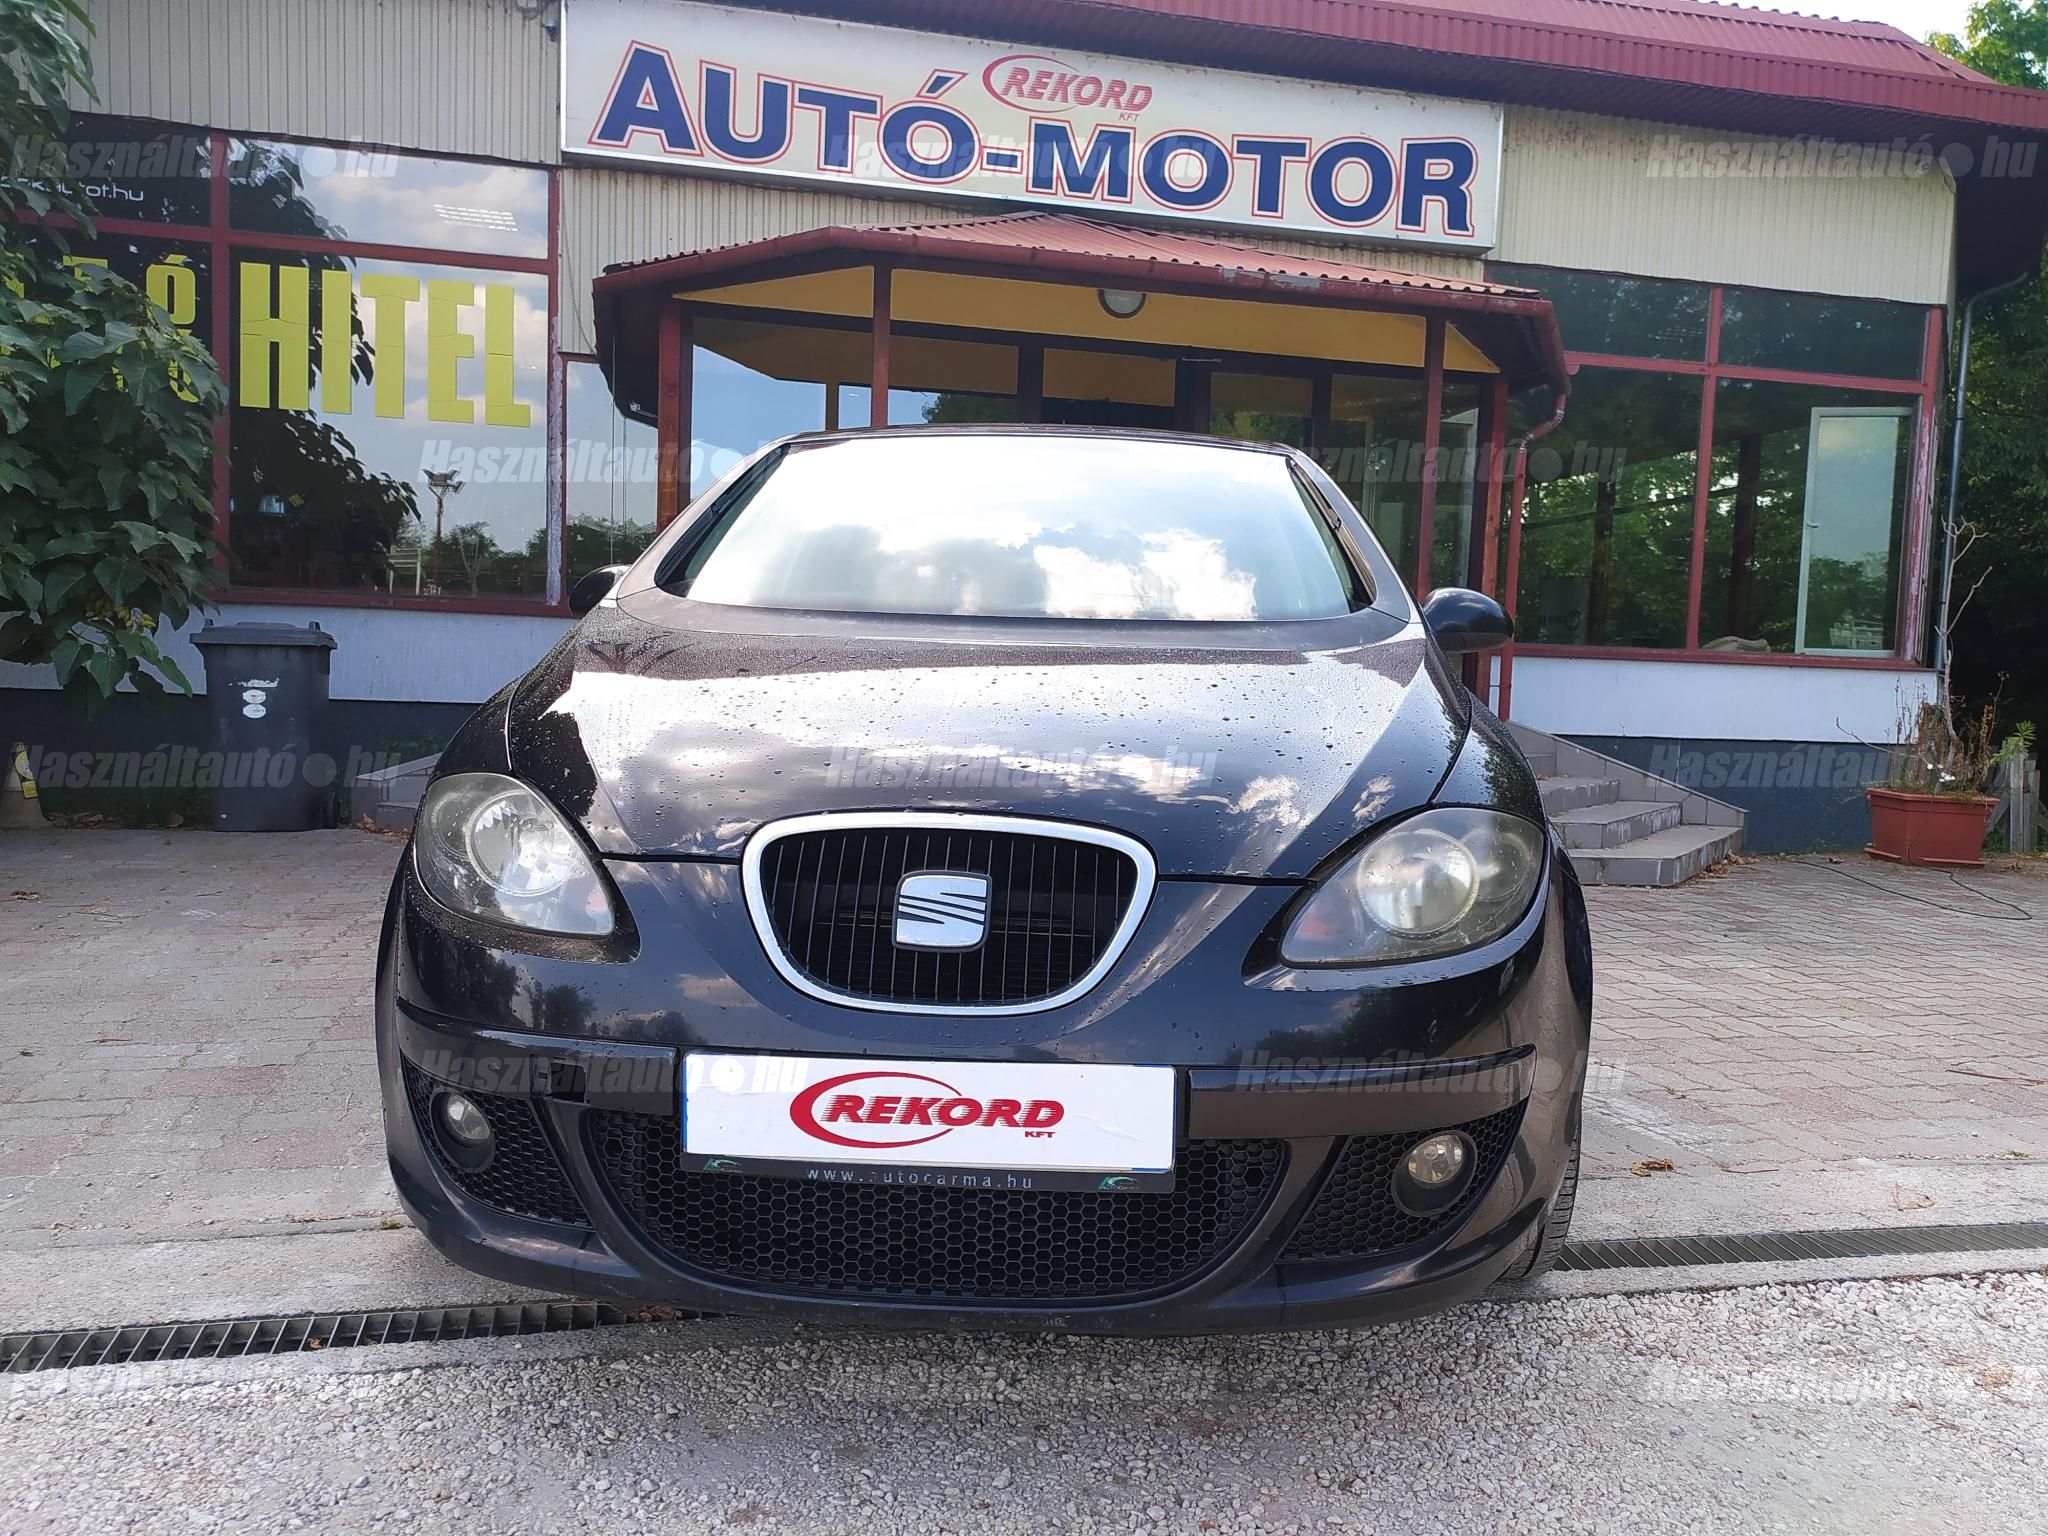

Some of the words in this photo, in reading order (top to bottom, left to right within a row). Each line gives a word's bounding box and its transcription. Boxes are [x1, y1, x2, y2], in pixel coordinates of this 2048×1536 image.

[1000, 66, 1153, 112] REKORD
[588, 40, 1475, 237] AUTÓ-MOTOR
[1118, 111, 1140, 122] KFT
[239, 261, 532, 428] HITEL
[820, 1095, 1064, 1128] REKORD
